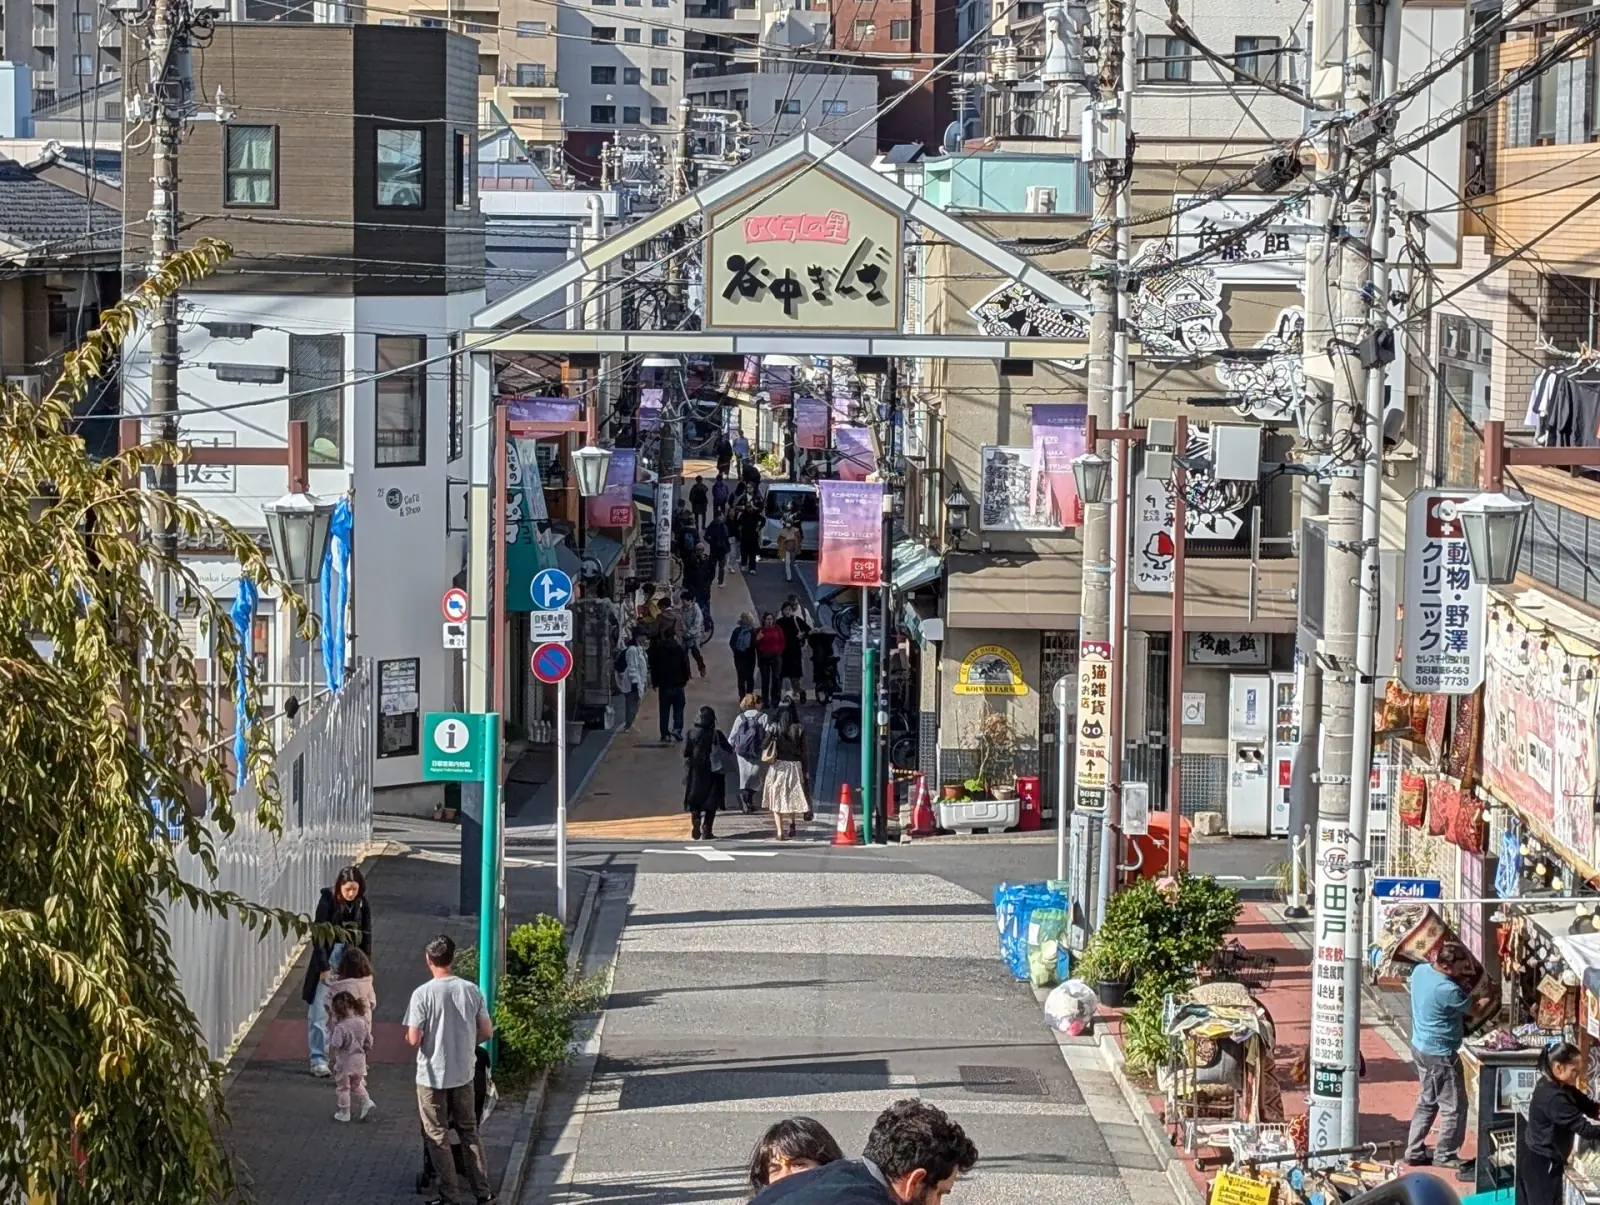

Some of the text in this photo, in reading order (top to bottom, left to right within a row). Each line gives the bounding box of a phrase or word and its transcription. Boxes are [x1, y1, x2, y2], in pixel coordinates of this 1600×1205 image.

[744, 210, 849, 243] ひぐらしの里
[722, 237, 892, 315] 谷中ぎんざ
[1419, 541, 1443, 651] クリニック
[1445, 541, 1470, 653] 動物・野澤
[534, 622, 569, 631] 一方通行
[966, 685, 1015, 693] KOIWAI FARM
[1080, 673, 1091, 709] のお店
[1091, 664, 1107, 716] 猫雑貨
[1415, 675, 1469, 686] 3894-7739
[1389, 882, 1425, 897] Asahi
[1317, 1081, 1342, 1093] 3-13
